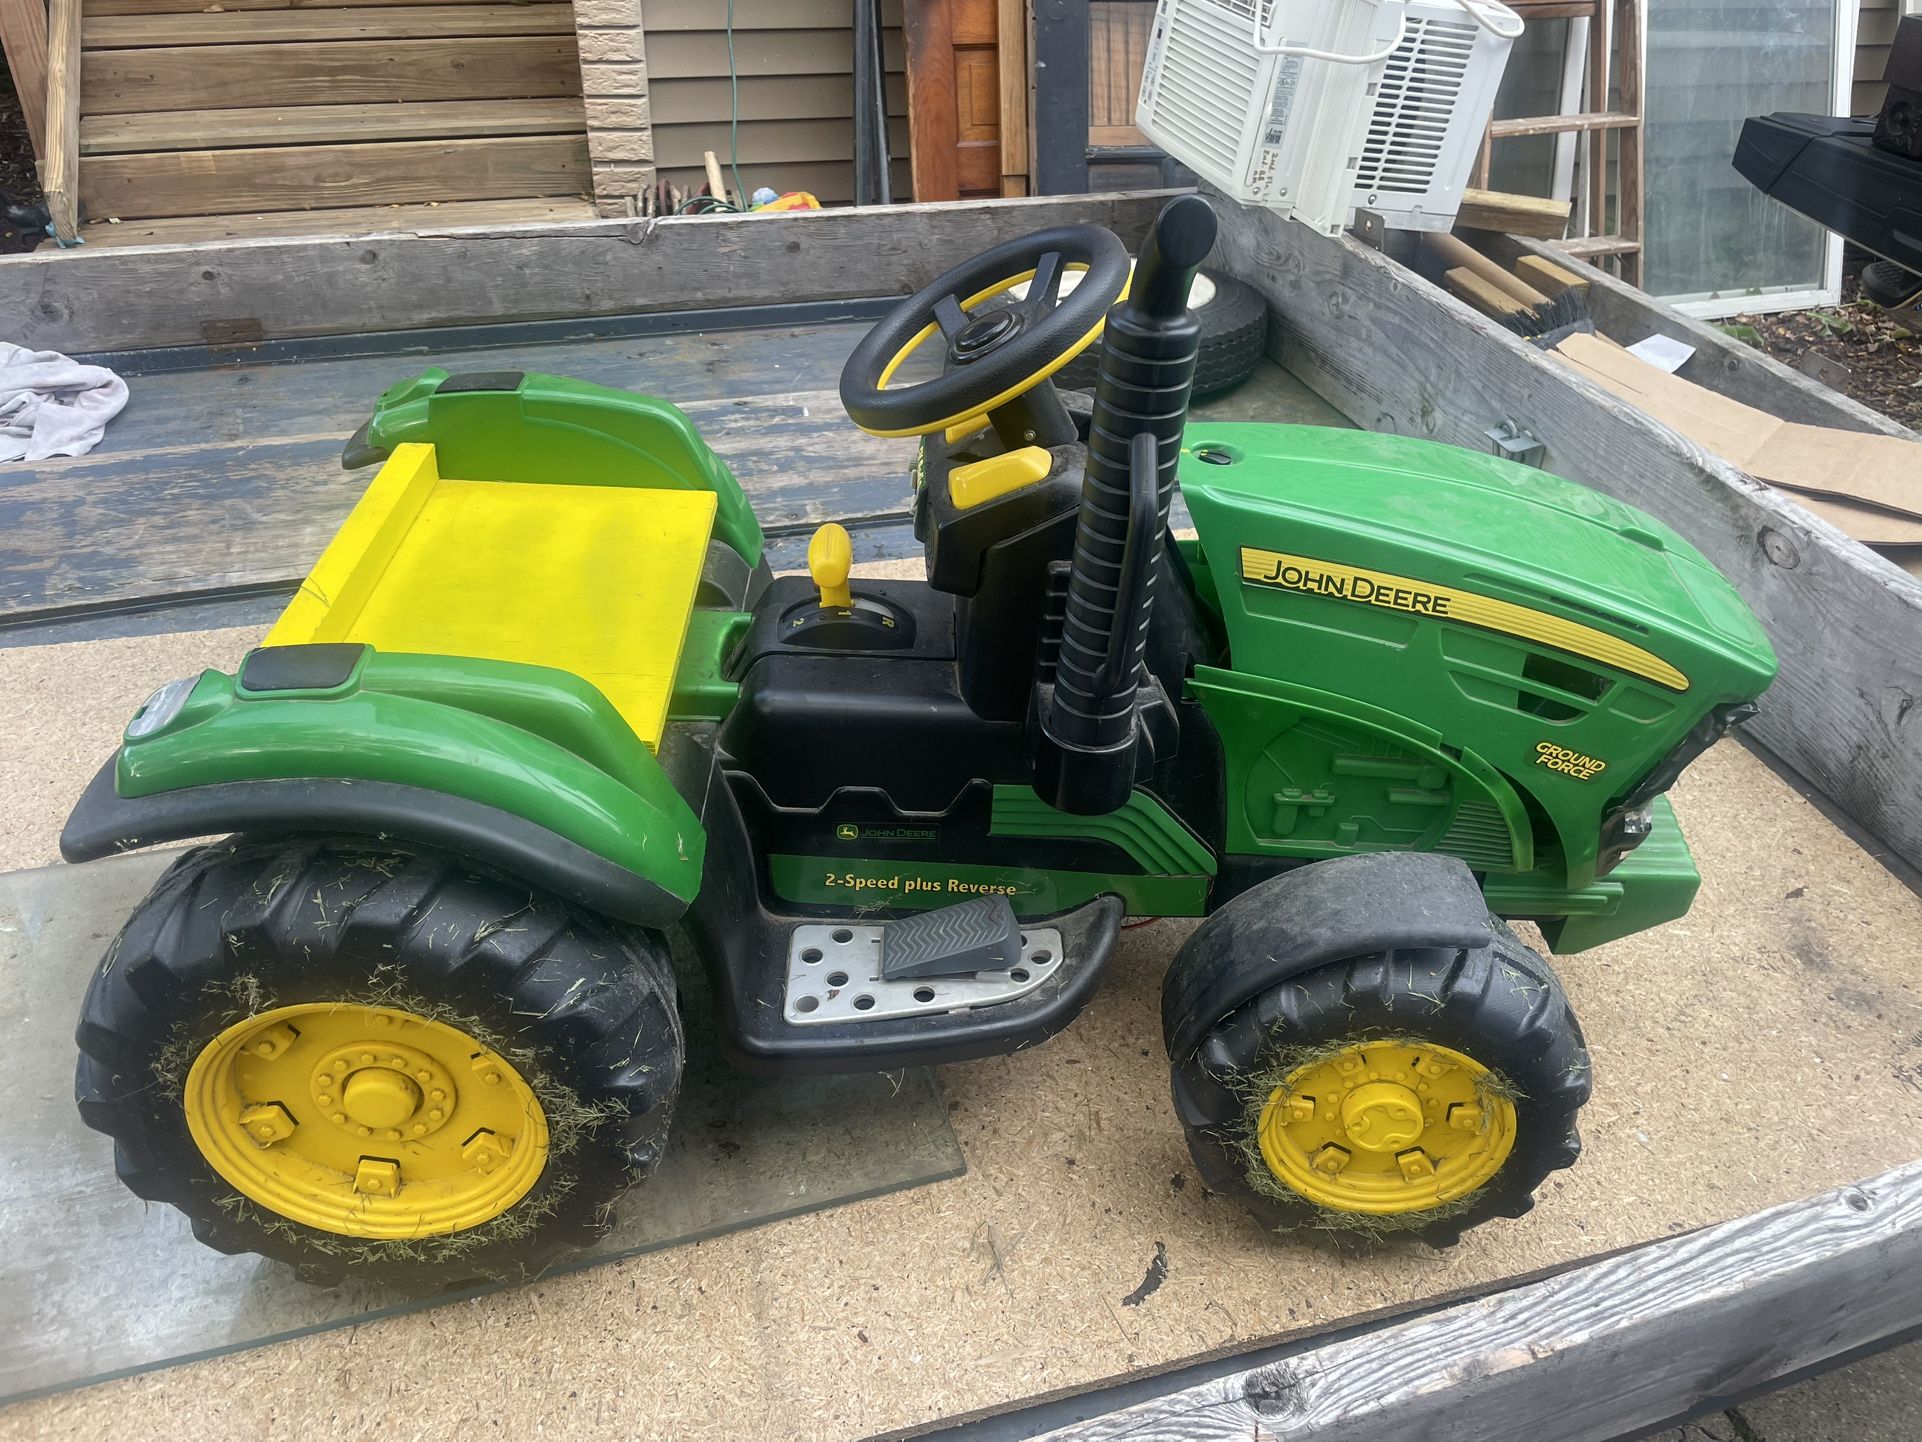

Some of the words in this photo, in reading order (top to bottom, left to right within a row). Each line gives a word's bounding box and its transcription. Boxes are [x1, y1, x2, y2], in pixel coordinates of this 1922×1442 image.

[1263, 560, 1345, 595] JOHN
[1350, 576, 1451, 615] DEERE
[792, 617, 805, 627] 2
[882, 616, 895, 628] R
[1535, 742, 1606, 772] GROUND
[1535, 753, 1595, 780] FORCE
[862, 828, 895, 837] JOHN
[896, 828, 937, 838] DEERE
[825, 873, 899, 891] 2-Speed
[904, 877, 941, 894] plus
[947, 879, 1017, 896] Reverse
